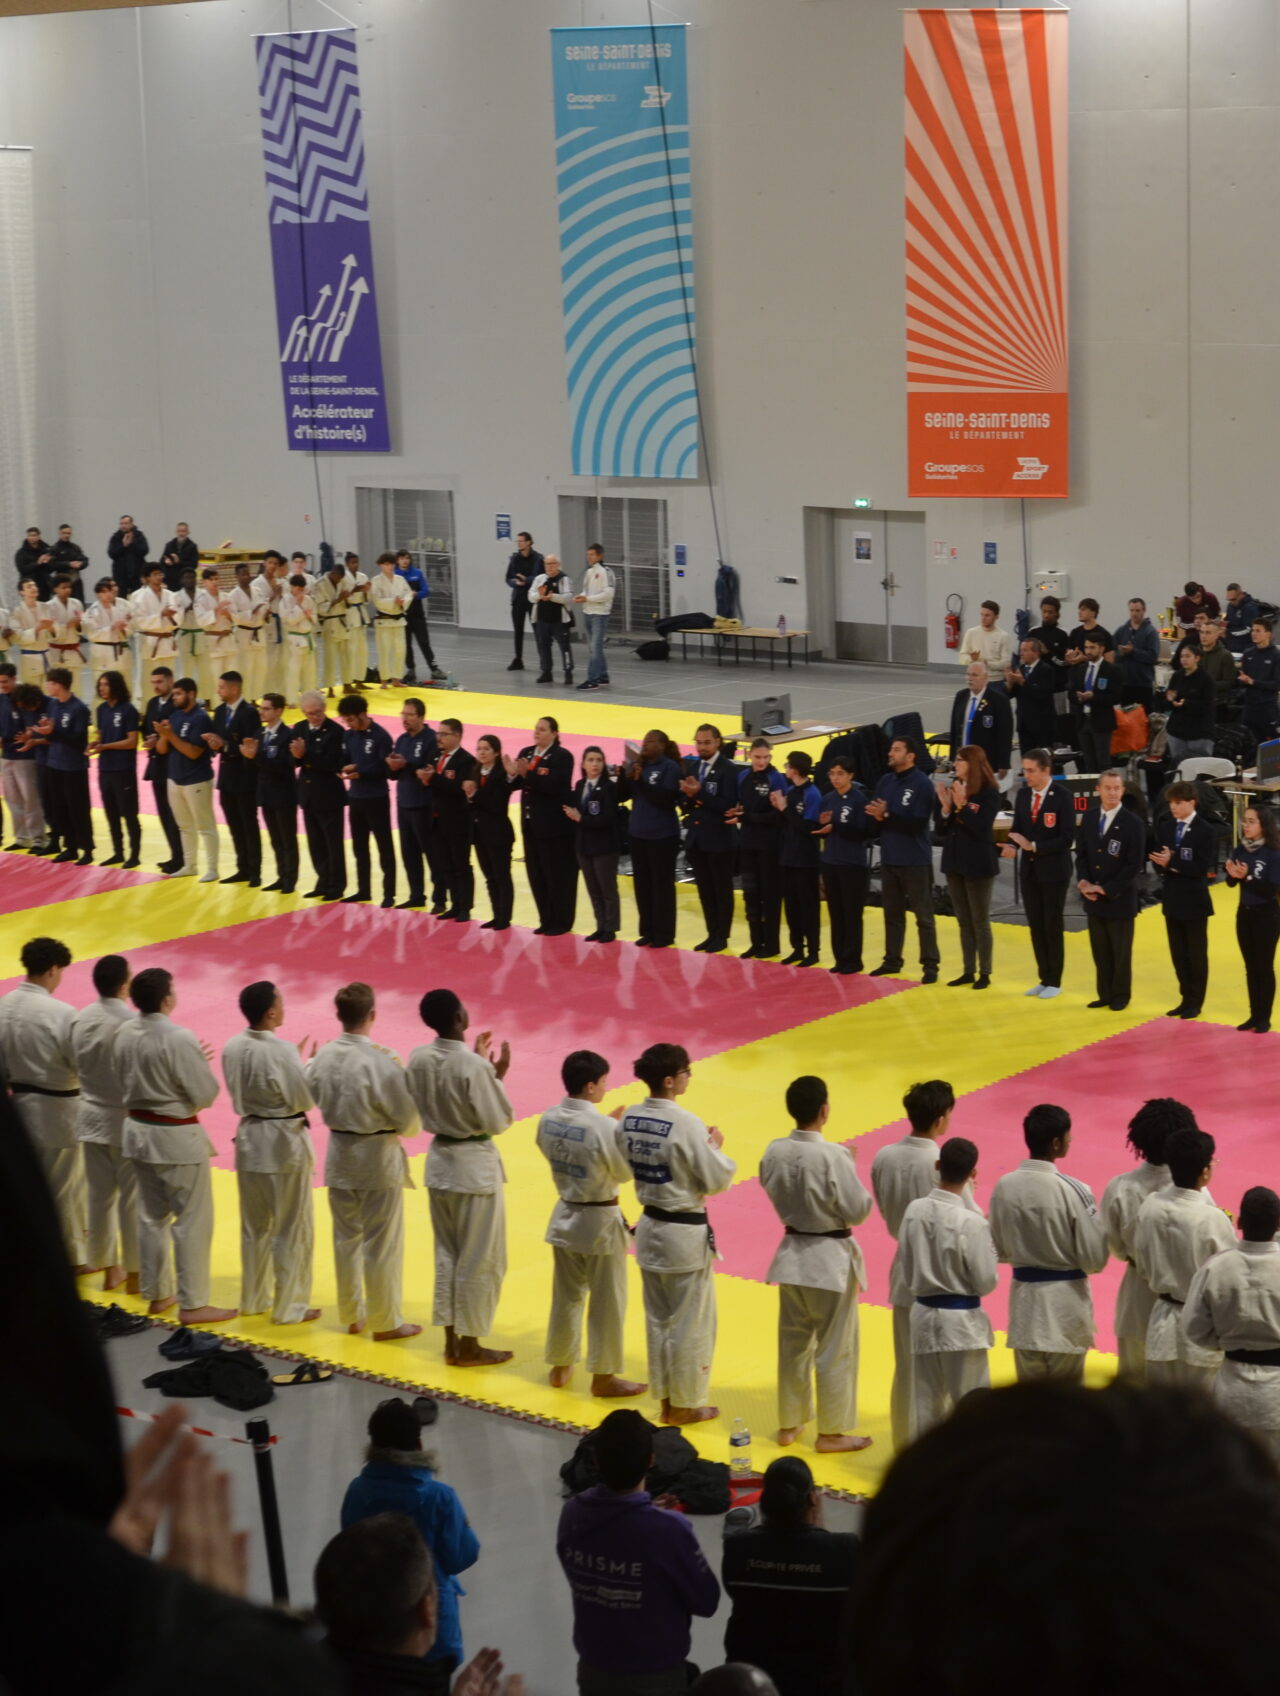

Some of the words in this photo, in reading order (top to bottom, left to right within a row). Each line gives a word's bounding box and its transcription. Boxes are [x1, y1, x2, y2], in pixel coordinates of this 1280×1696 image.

[292, 403, 375, 419] Accélérateur
[294, 424, 366, 443] d'histoire(s)
[949, 431, 960, 440] LE
[963, 430, 1025, 440] DÉPARTEMENT
